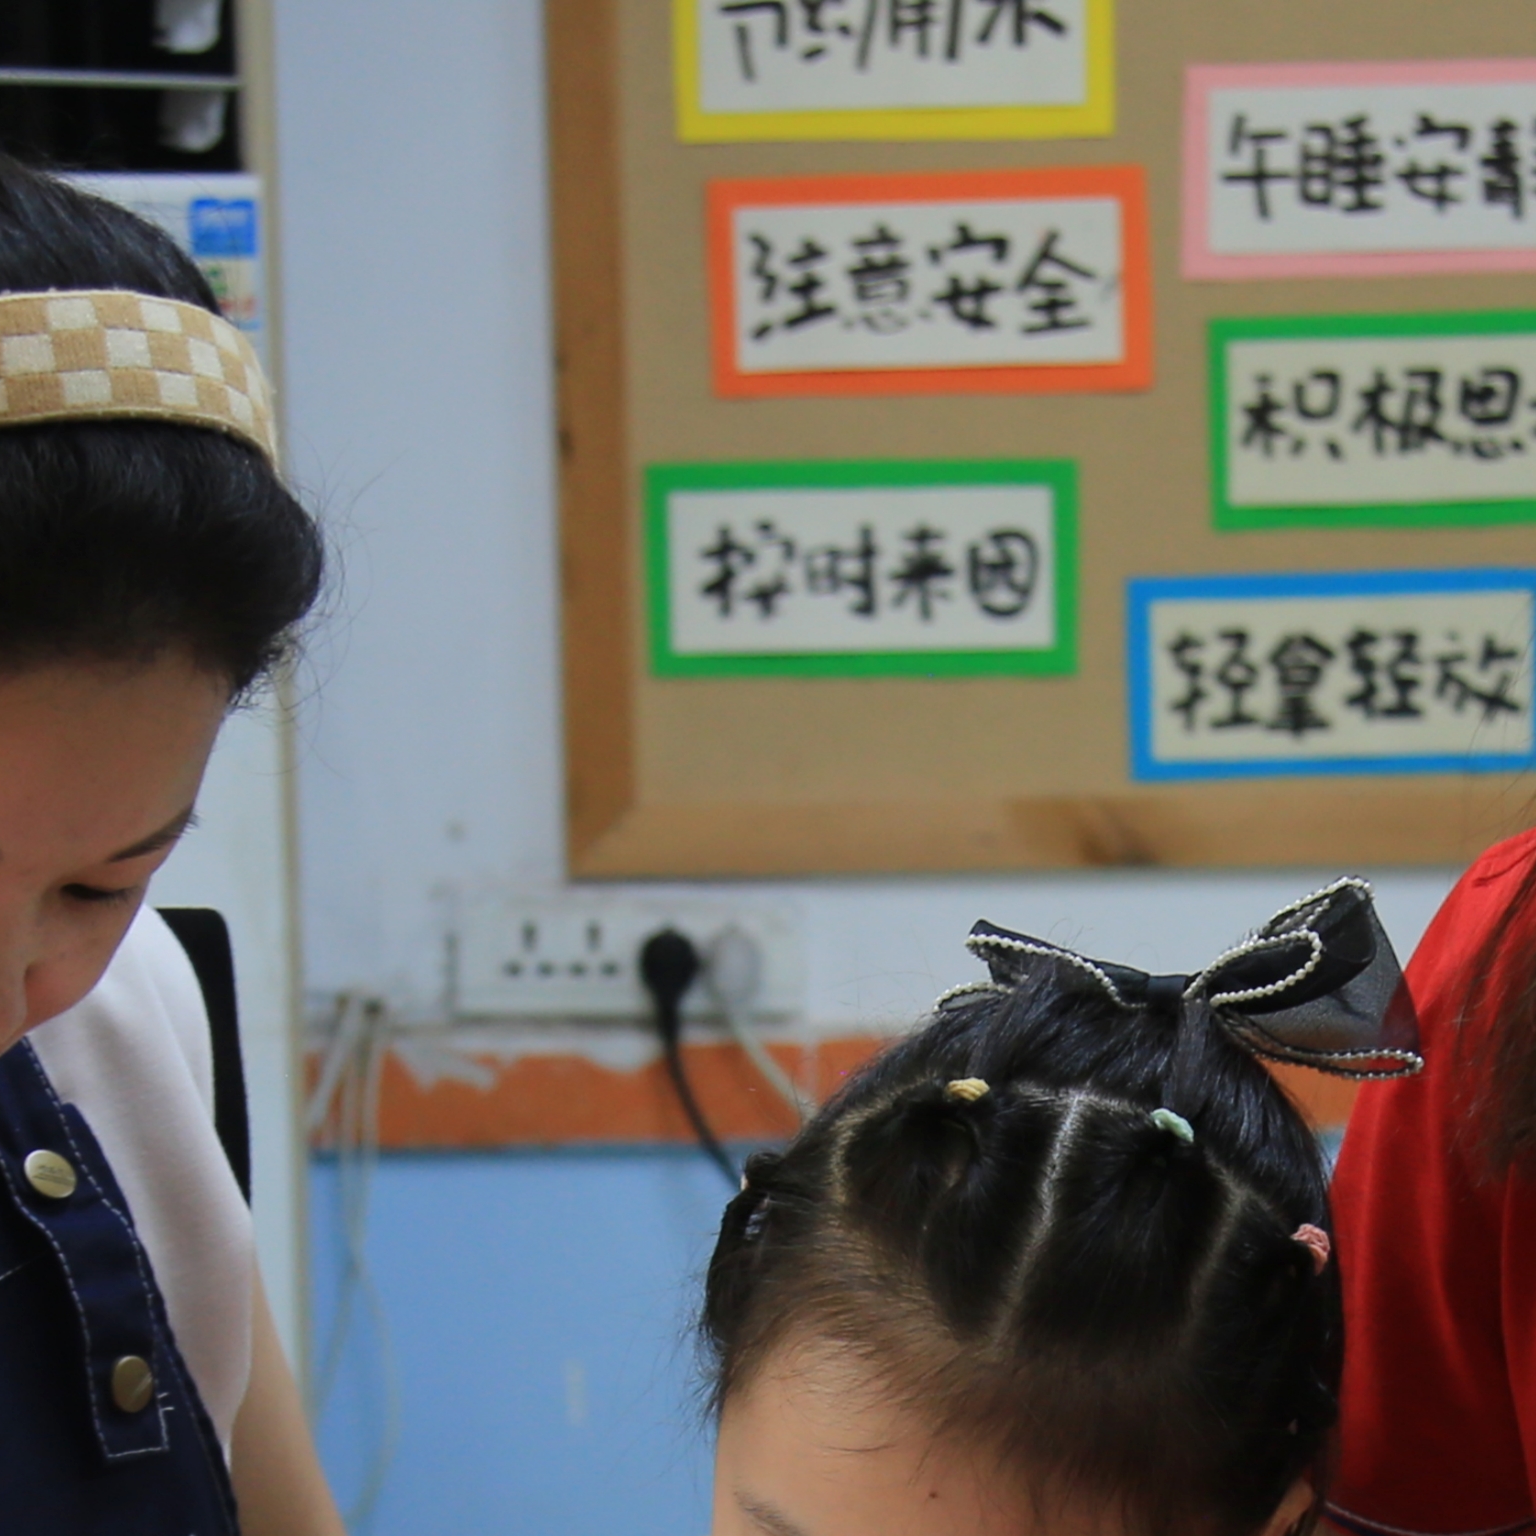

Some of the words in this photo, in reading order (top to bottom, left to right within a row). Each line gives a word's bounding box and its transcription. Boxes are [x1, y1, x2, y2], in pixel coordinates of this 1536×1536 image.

[748, 225, 1098, 341] 注意安全
[699, 517, 1040, 621] 按时来园
[1165, 626, 1525, 740] 轻拿轻放
